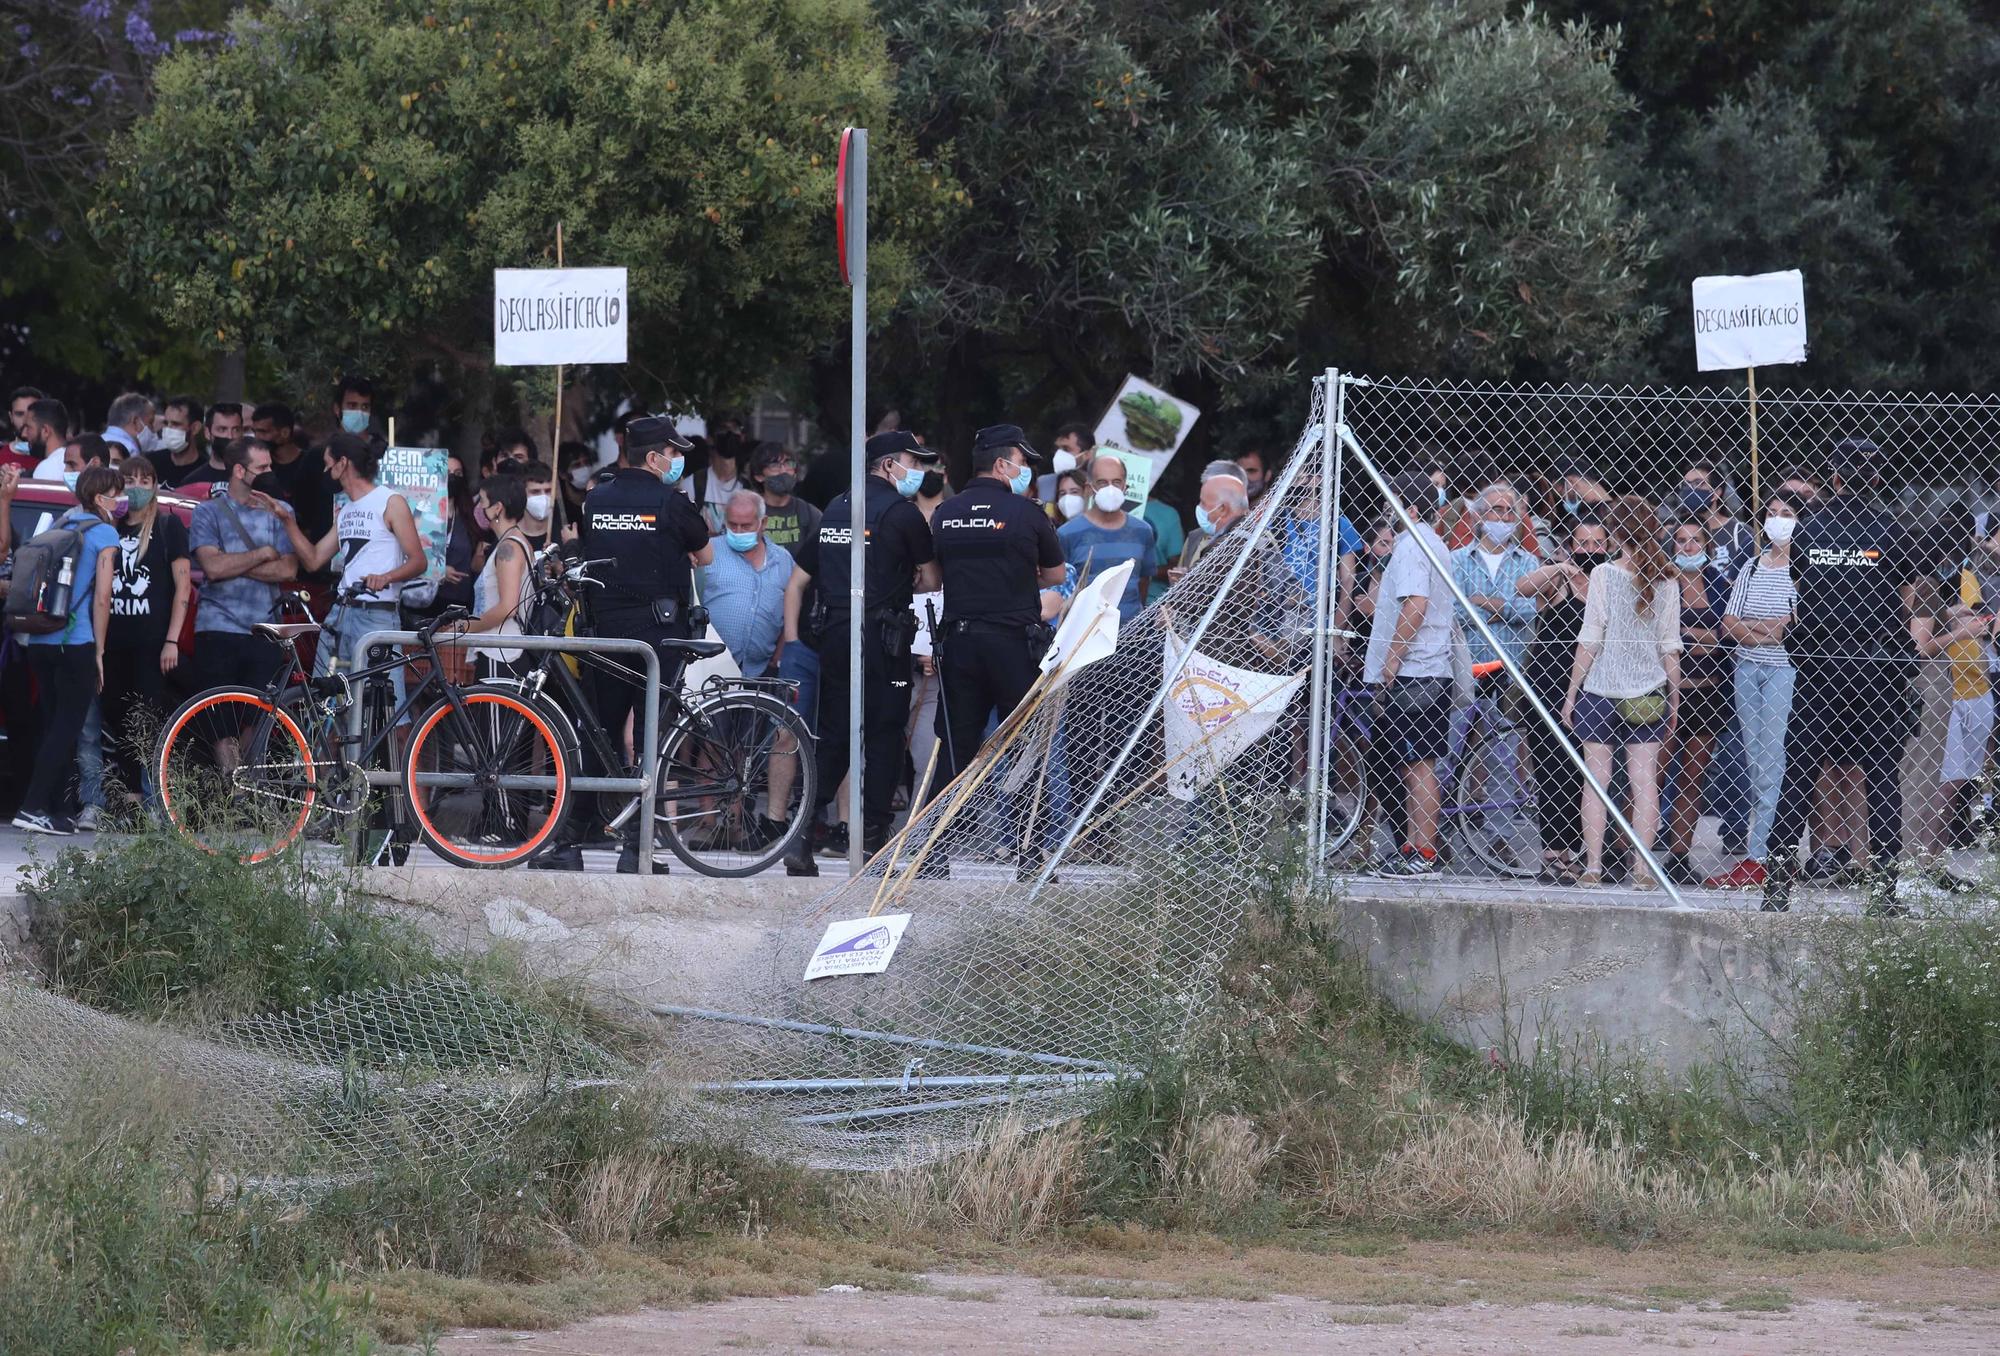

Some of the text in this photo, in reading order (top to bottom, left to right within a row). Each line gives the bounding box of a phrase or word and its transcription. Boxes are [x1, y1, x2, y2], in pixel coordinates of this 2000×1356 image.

[381, 472, 439, 488] L'HORTA
[592, 514, 642, 522] POLICIA
[592, 522, 656, 531] NACIONAL
[942, 519, 997, 529] POLICIA
